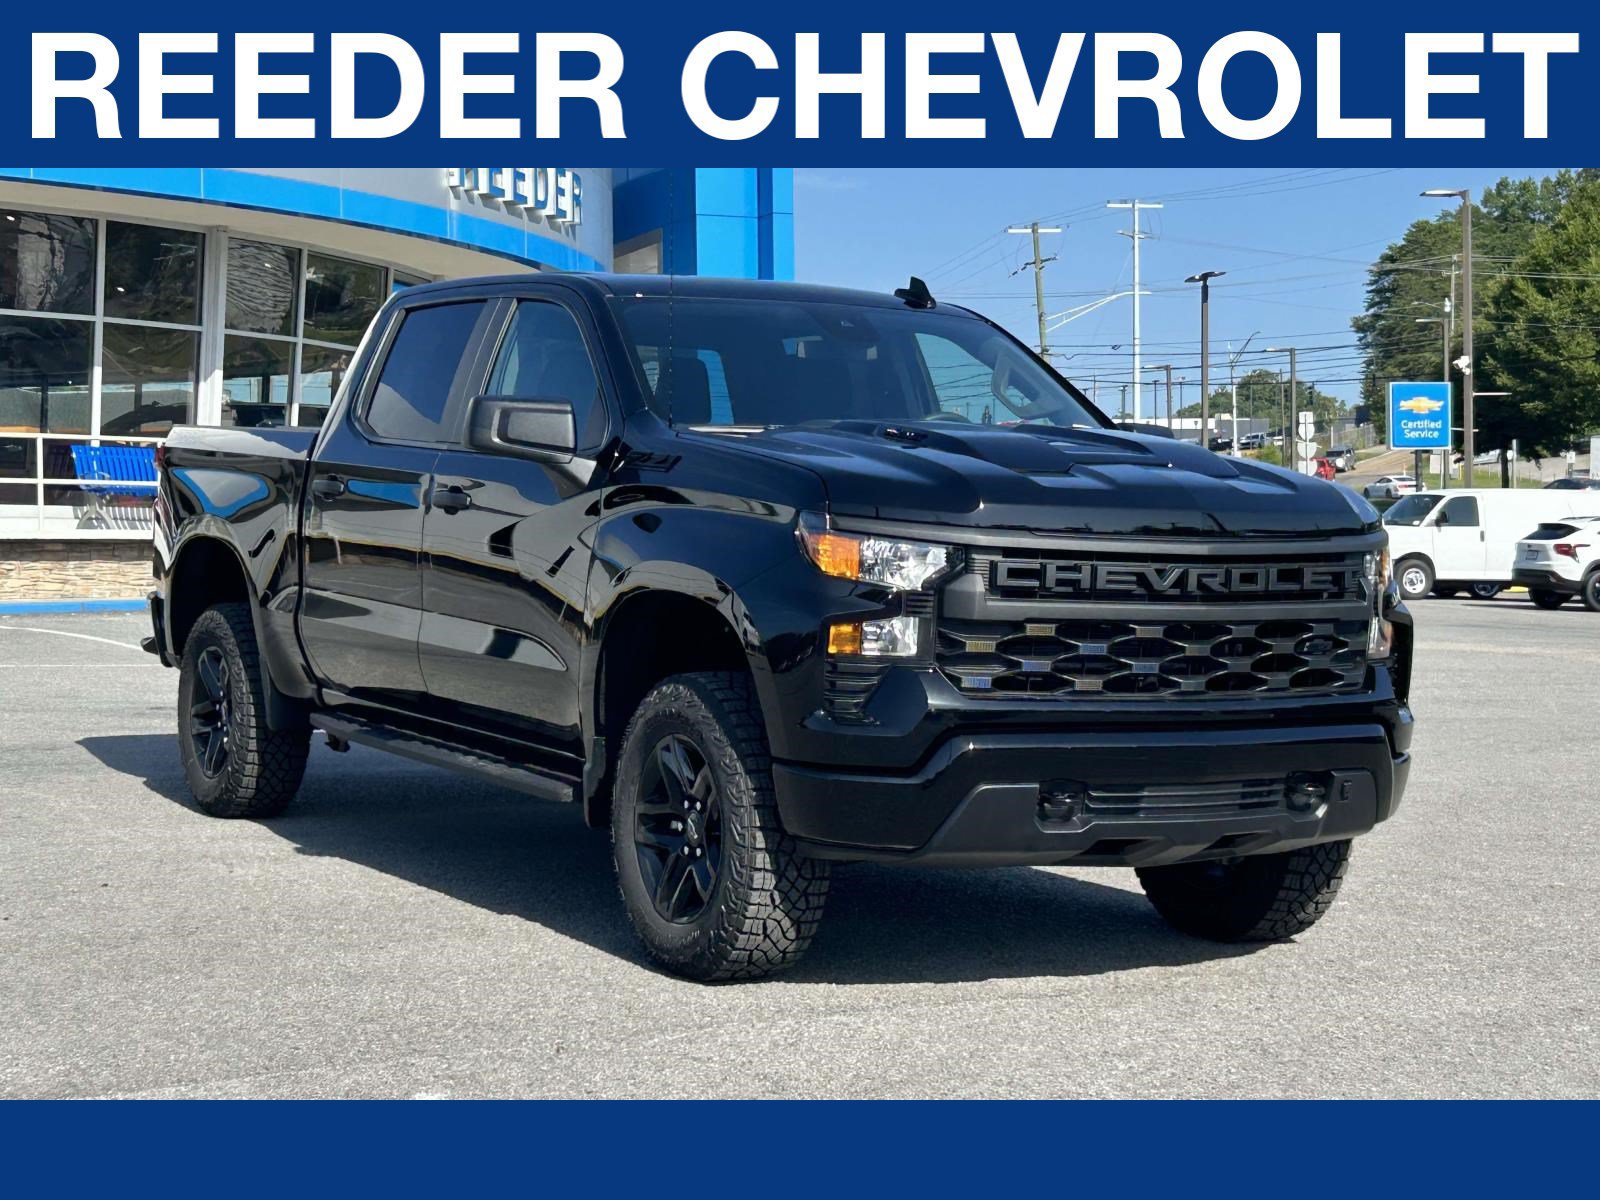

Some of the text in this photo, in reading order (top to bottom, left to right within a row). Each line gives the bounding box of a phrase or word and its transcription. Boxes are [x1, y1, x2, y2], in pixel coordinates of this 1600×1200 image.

[1401, 419, 1442, 429] Certified
[1404, 429, 1440, 438] Service
[994, 558, 1363, 593] CHEVROLET
